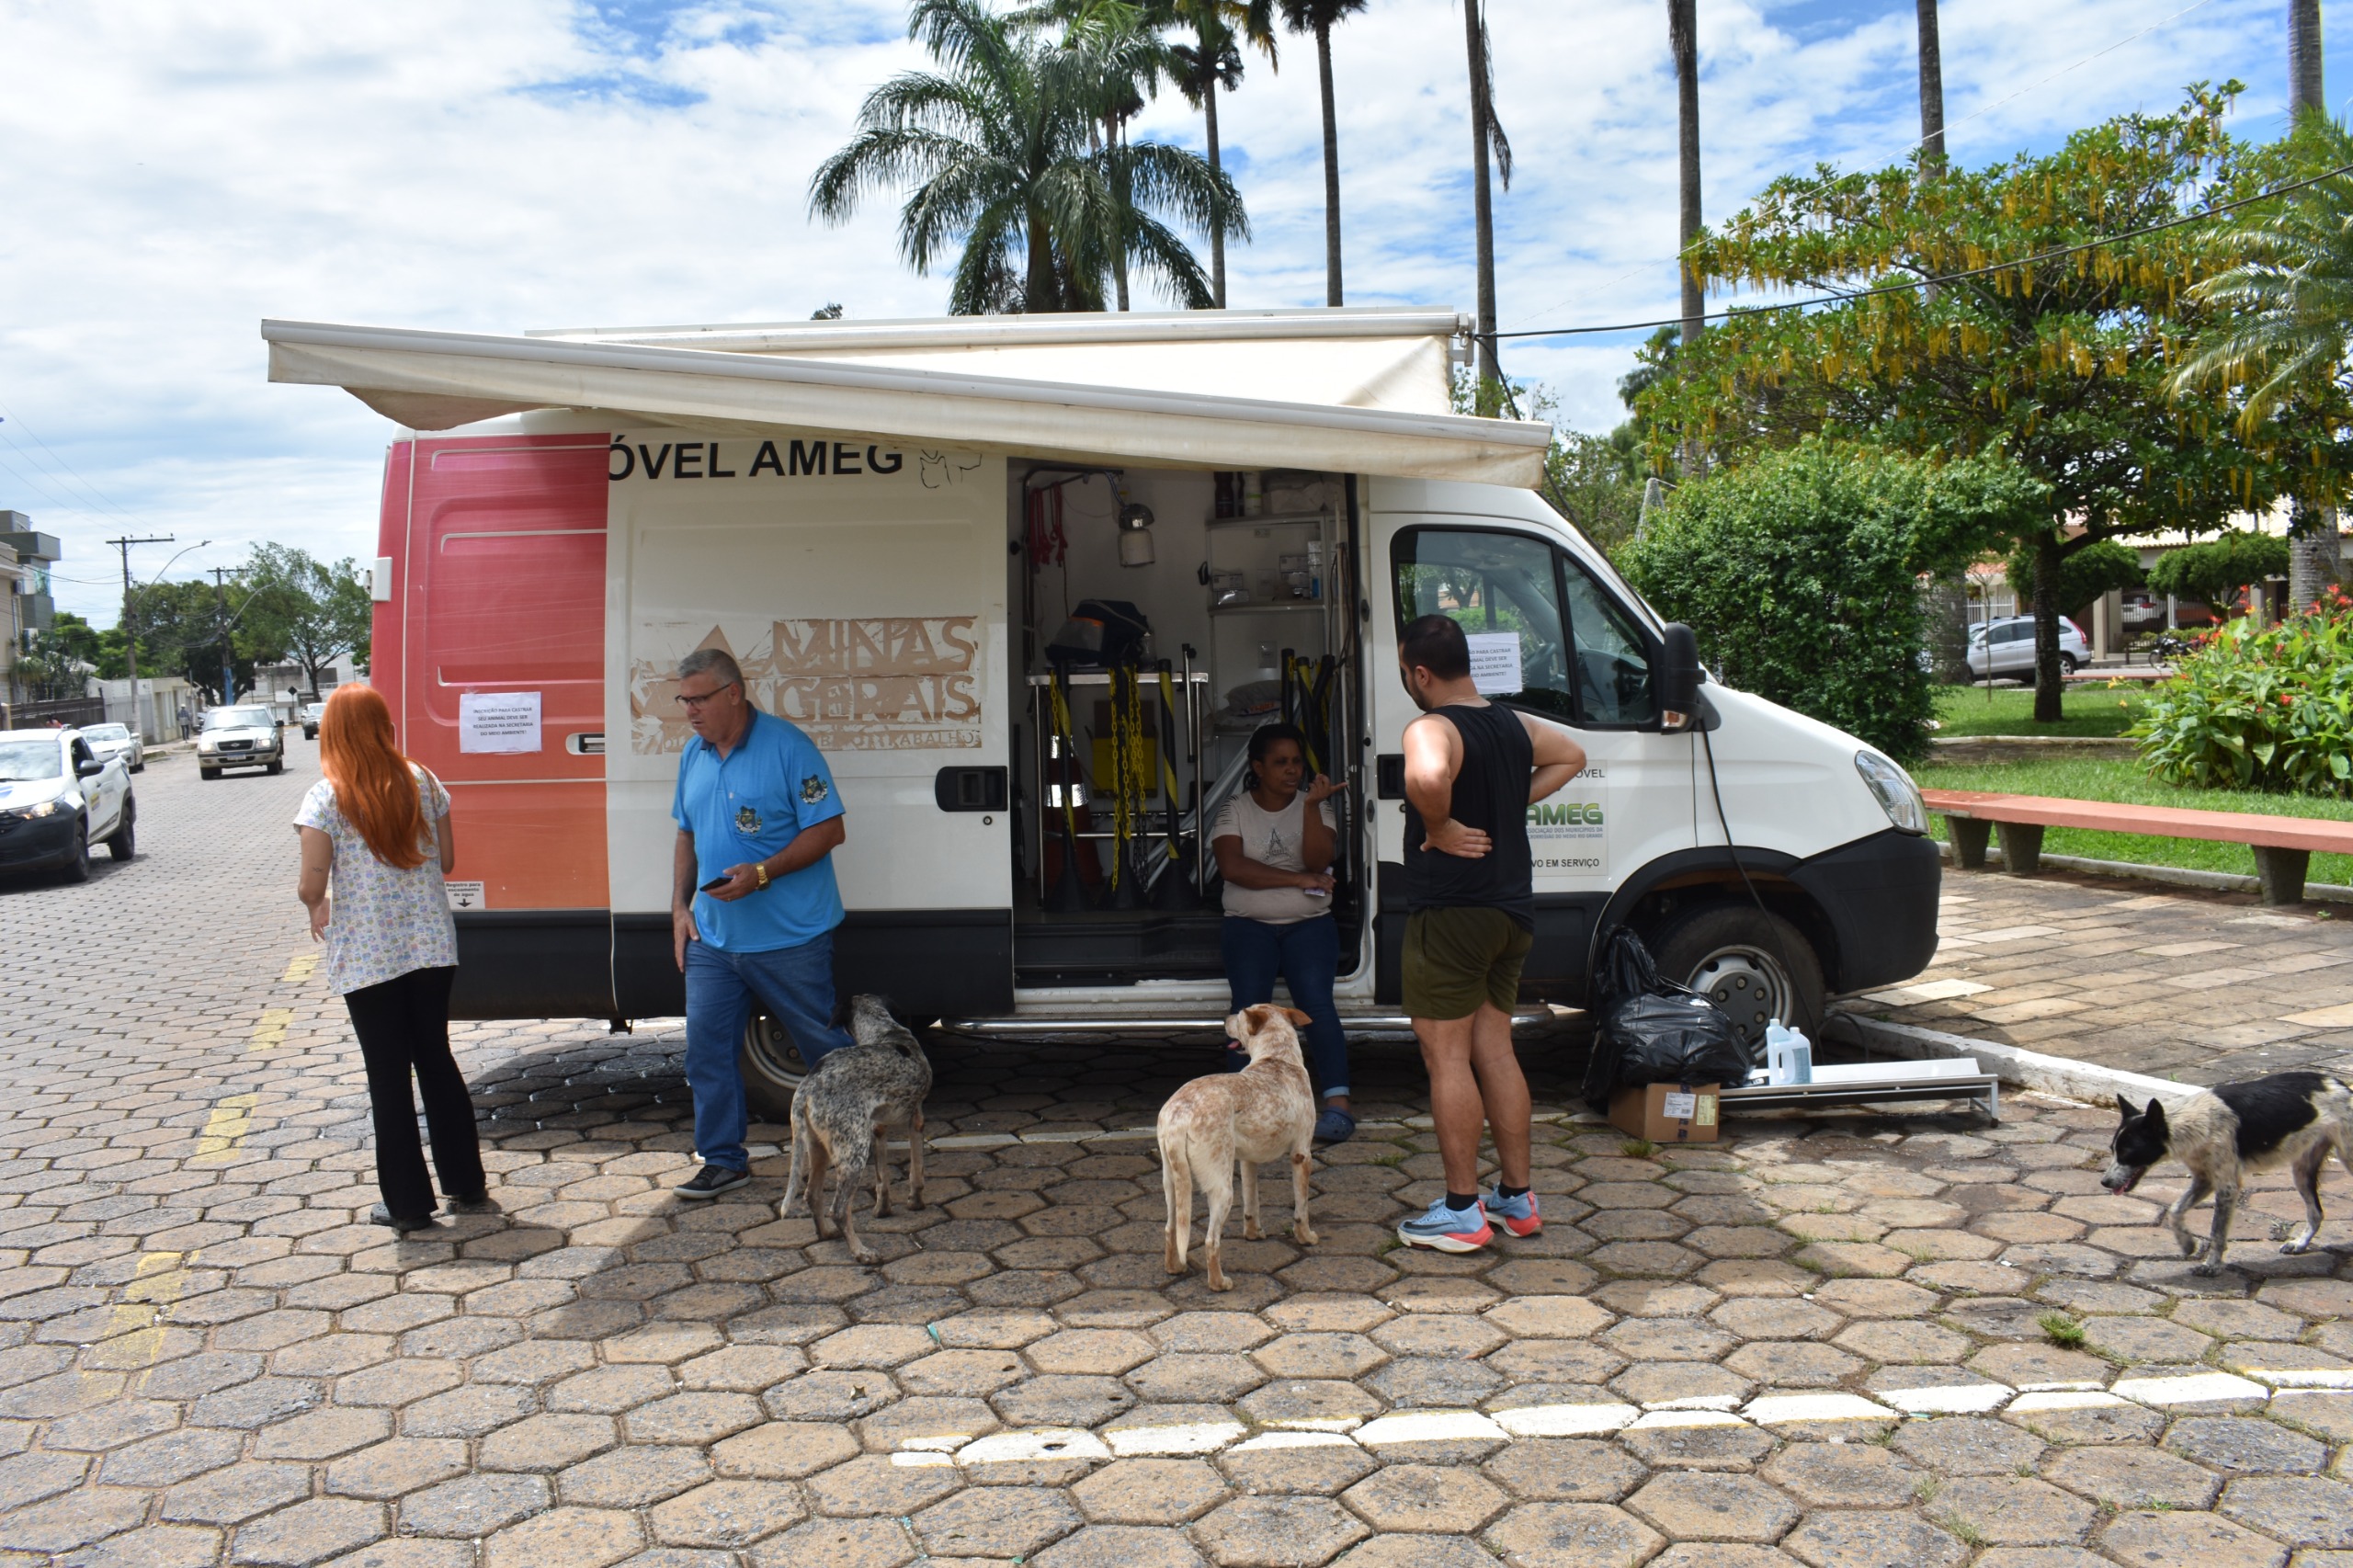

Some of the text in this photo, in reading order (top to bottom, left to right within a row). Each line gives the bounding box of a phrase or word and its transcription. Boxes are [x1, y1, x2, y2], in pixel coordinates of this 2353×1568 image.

[748, 440, 904, 477] AMEG
[773, 617, 975, 668] MINAS
[774, 675, 975, 722] GERAIS
[1526, 802, 1604, 826] AMEG
[1546, 858, 1559, 867] EM
[1561, 858, 1600, 869] SERVIÇO
